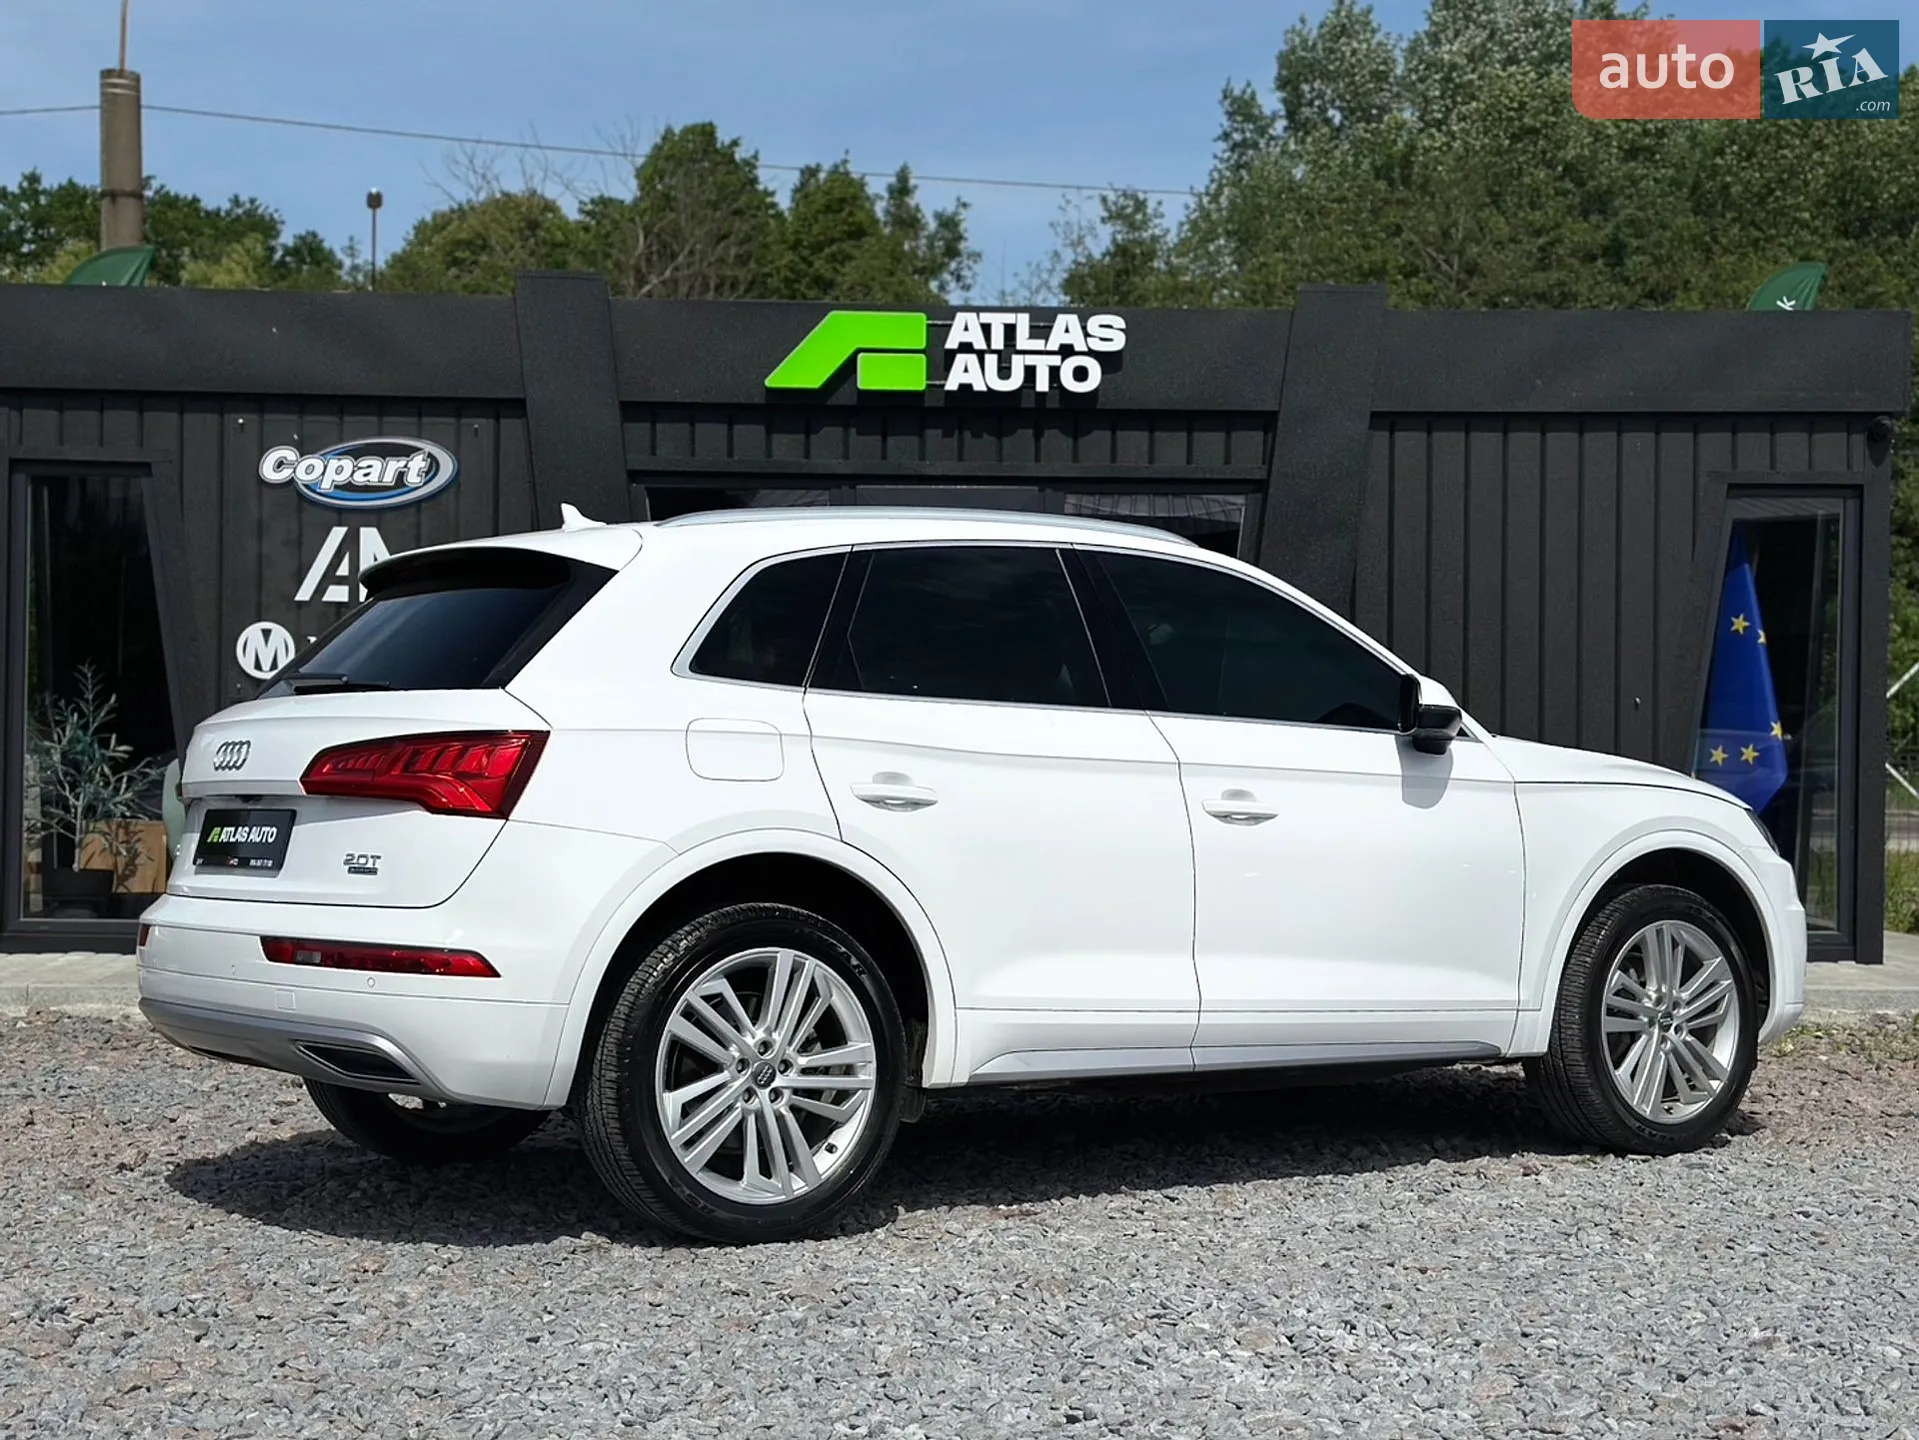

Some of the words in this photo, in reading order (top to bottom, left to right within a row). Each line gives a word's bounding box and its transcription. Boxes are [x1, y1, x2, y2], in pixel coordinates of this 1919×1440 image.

[944, 312, 1127, 352] ATLAS
[944, 353, 1102, 393] AUTO
[259, 446, 431, 491] Copart
[219, 826, 250, 843] ATLAS
[247, 826, 278, 843] AUTO
